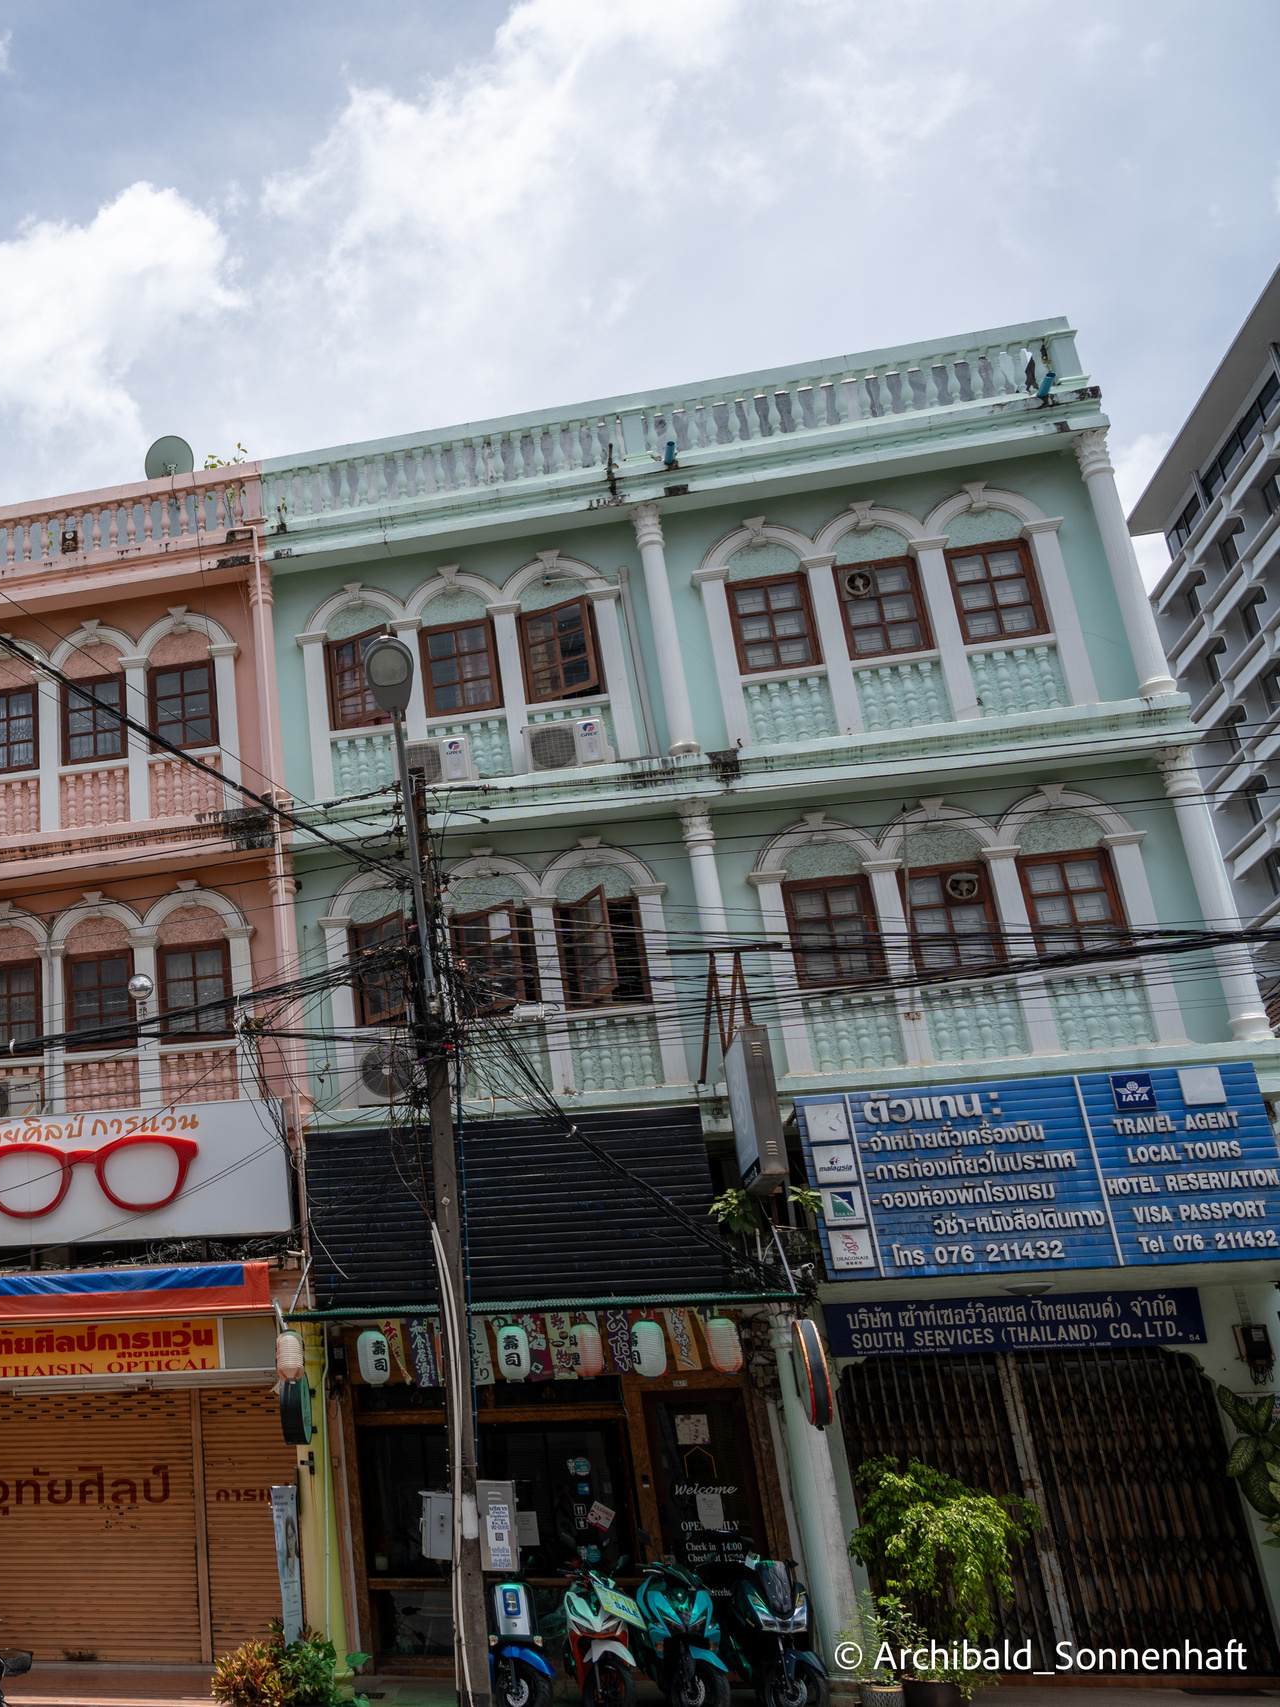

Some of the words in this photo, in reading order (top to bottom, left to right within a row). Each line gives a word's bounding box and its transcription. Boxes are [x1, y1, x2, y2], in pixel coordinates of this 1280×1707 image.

[863, 1092, 983, 1124] ตัวแทน
[1122, 1093, 1149, 1102] IATA
[91, 1106, 200, 1136] การแว่น
[1112, 1116, 1177, 1135] TRAVEL
[1185, 1111, 1239, 1131] AGENT
[1126, 1145, 1182, 1164] LOCAL
[1183, 1140, 1242, 1160] TOURS
[818, 1164, 853, 1173] malaysia
[1106, 1176, 1161, 1195] HOTEL
[1165, 1169, 1280, 1192] RESERVATION
[1132, 1206, 1173, 1224] VISA
[1179, 1200, 1267, 1221] PASSPORT
[934, 1244, 975, 1264] 076
[986, 1240, 1065, 1262] 211432
[1138, 1235, 1165, 1254] Tel
[1172, 1234, 1205, 1252] 076
[1215, 1229, 1280, 1250] 211432
[846, 1306, 893, 1330] บริษัท
[1130, 1294, 1178, 1317] จำกัด
[851, 1331, 905, 1349] SOUTH
[914, 1327, 995, 1347] SERVICES
[1000, 1323, 1099, 1345] (THAILAND)
[409, 1319, 433, 1387] 和食居酒屋
[107, 1358, 215, 1375] OPTICAL
[674, 1484, 738, 1495] Welcome
[593, 1504, 613, 1518] CLOSED
[686, 1542, 707, 1551] Check
[709, 1542, 717, 1551] in
[607, 1590, 638, 1613] ขาย
[614, 1601, 640, 1619] SALE
